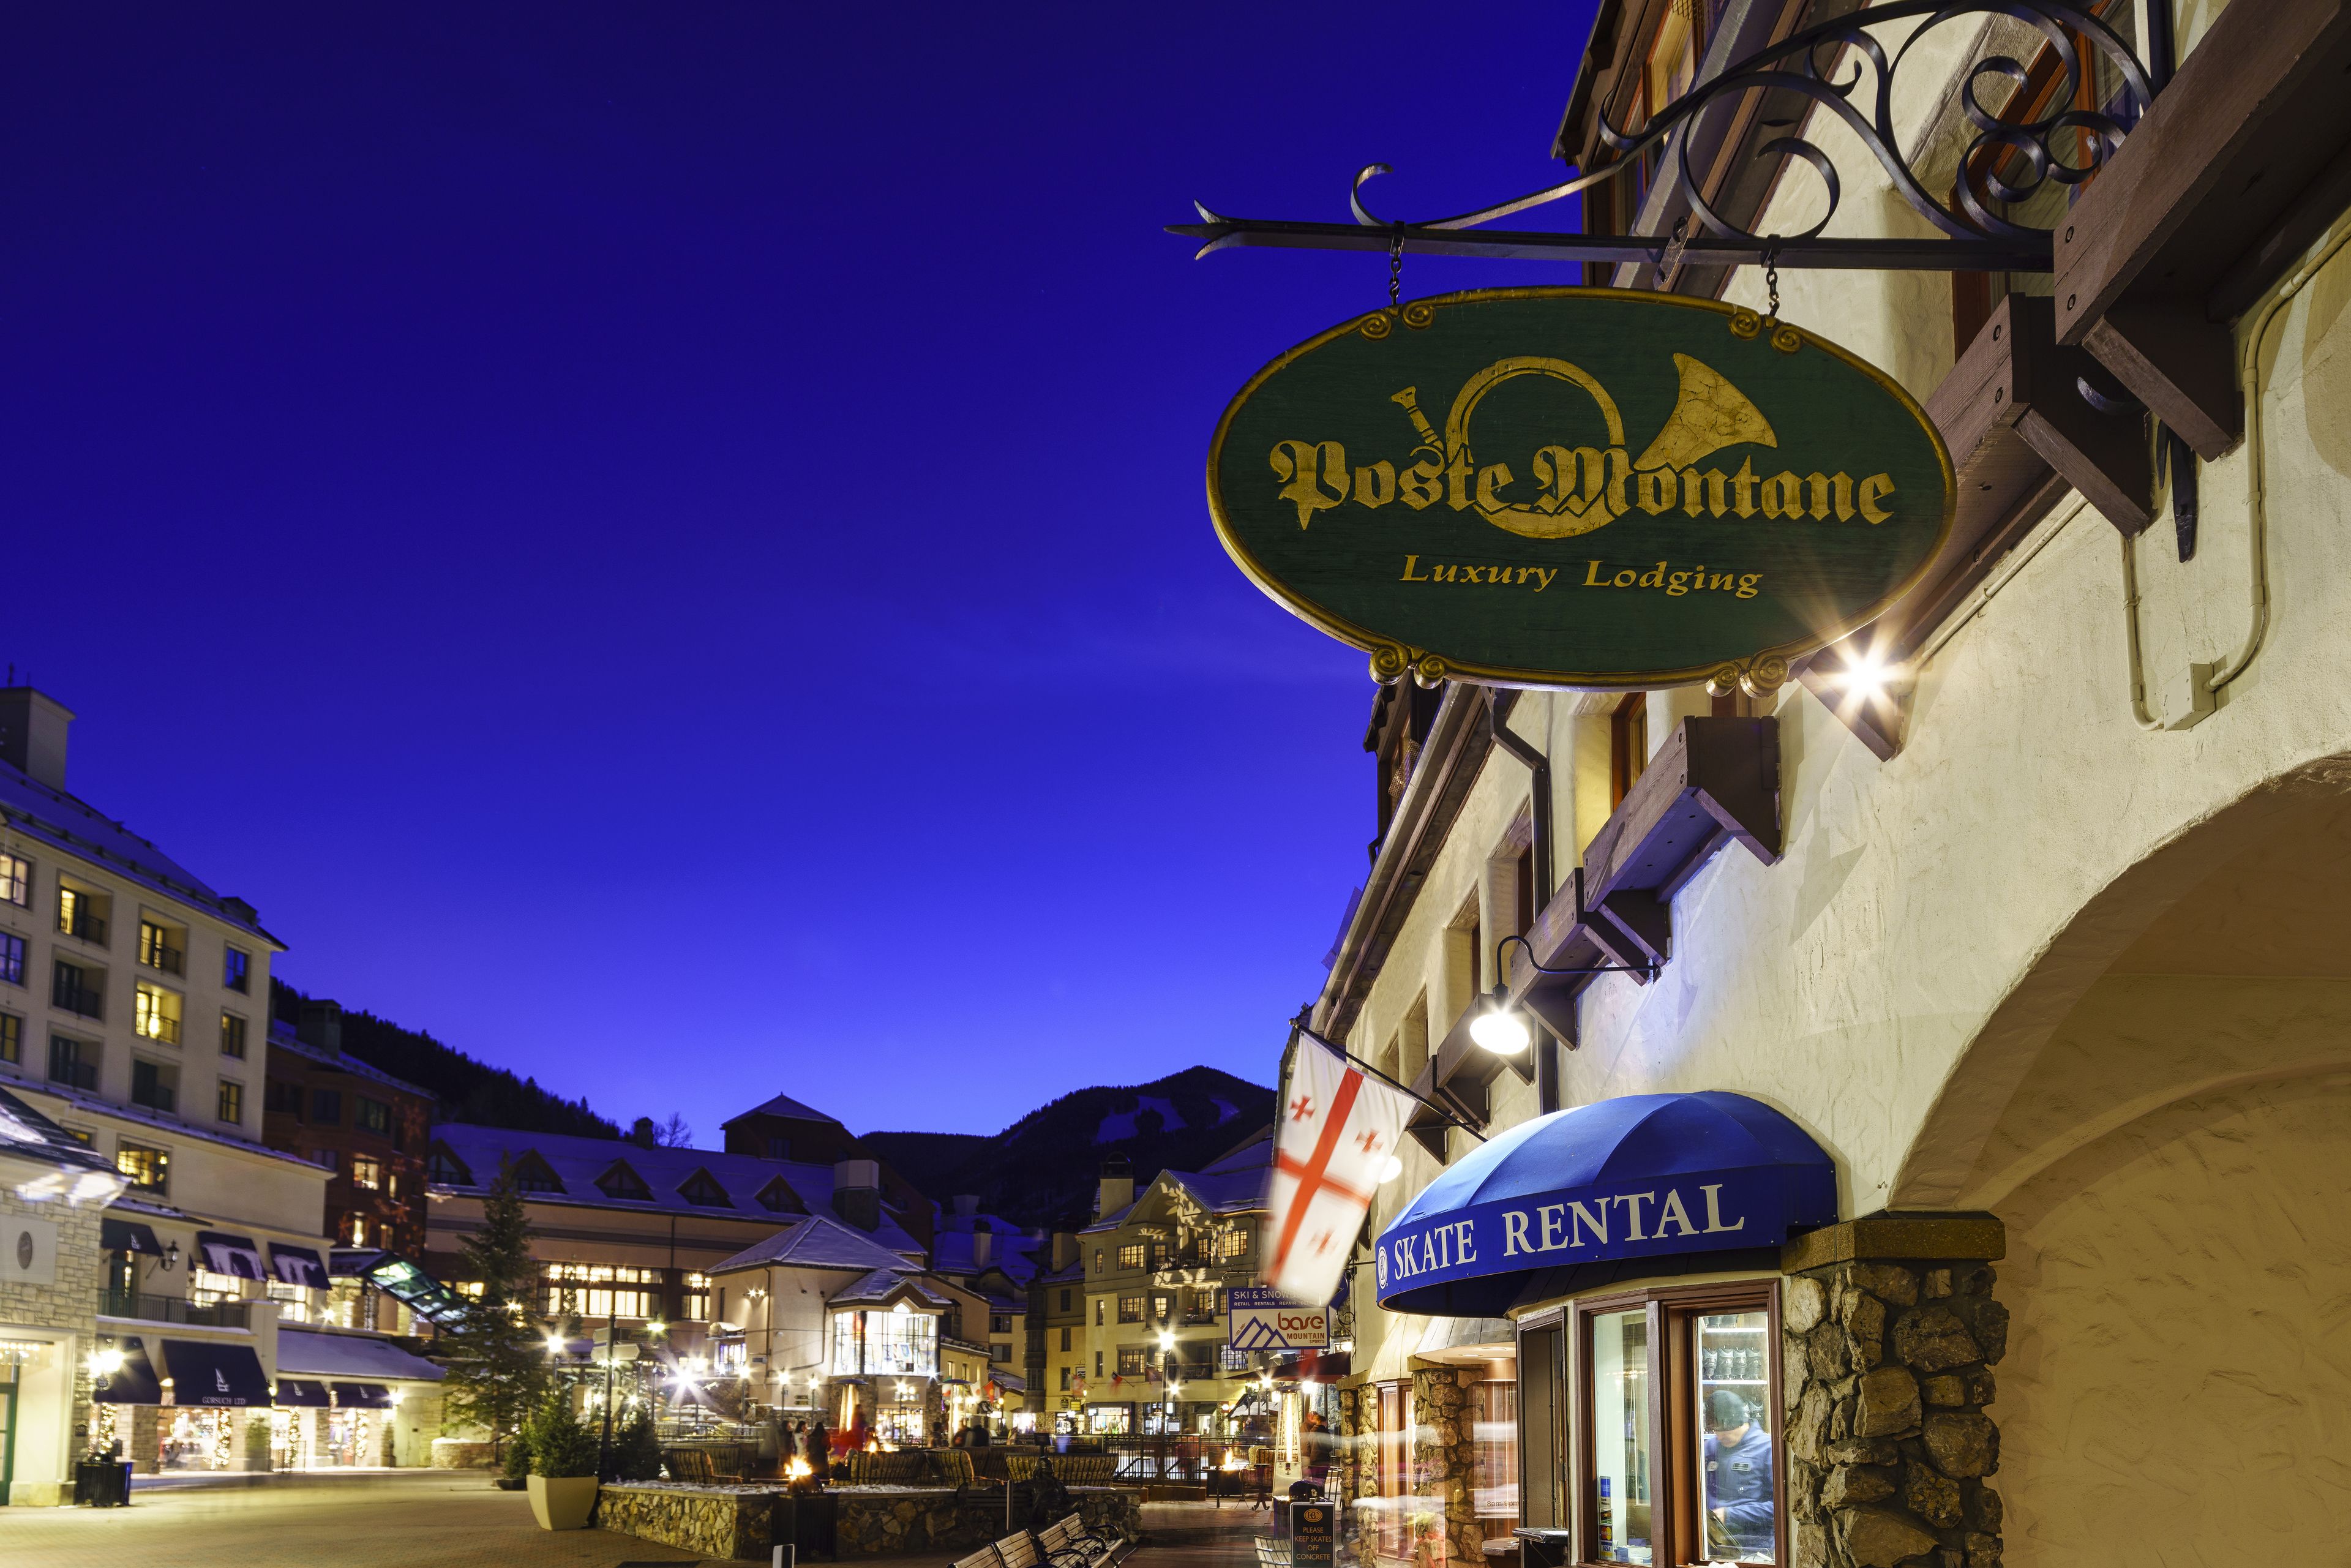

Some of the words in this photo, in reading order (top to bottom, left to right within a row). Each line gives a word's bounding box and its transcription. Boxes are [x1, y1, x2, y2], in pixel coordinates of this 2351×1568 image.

[1269, 440, 1514, 531] Poste
[1532, 445, 1895, 525] Montane
[1399, 554, 1558, 593] Luxury
[1581, 560, 1764, 599] Lodging
[1393, 1219, 1477, 1280] SKATE
[1502, 1183, 1745, 1258] RENTAL
[1234, 1291, 1250, 1299] SKI
[1252, 1291, 1259, 1299] &
[202, 1396, 231, 1405] GORSUCH
